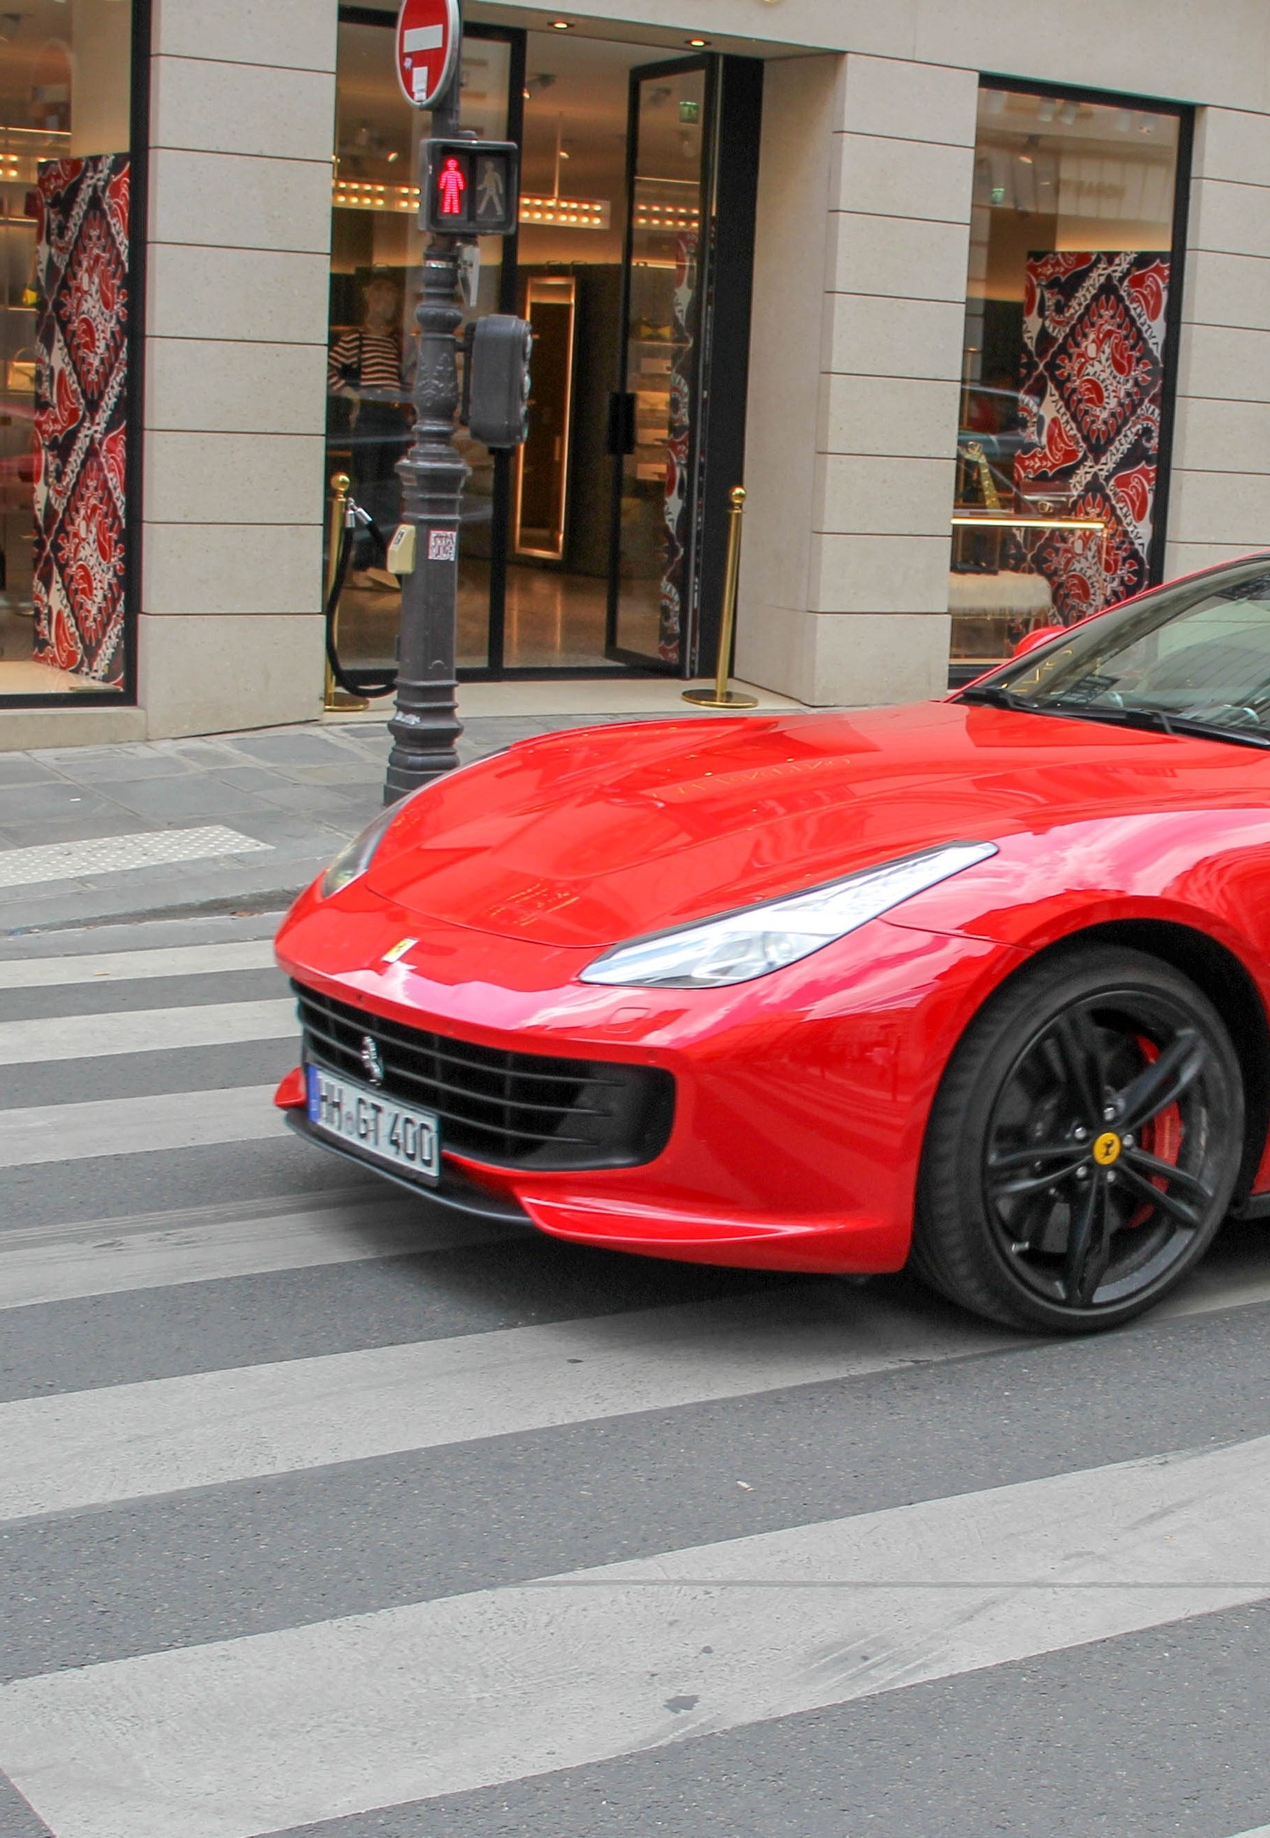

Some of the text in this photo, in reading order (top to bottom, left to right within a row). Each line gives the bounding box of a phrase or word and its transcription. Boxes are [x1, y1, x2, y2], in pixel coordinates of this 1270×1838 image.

[1122, 285, 1158, 353] VALENTNO
[1049, 387, 1083, 454] VALENTNO
[1109, 484, 1146, 554] VALENTNO
[357, 1097, 383, 1147] GT
[389, 1110, 435, 1168] 400
